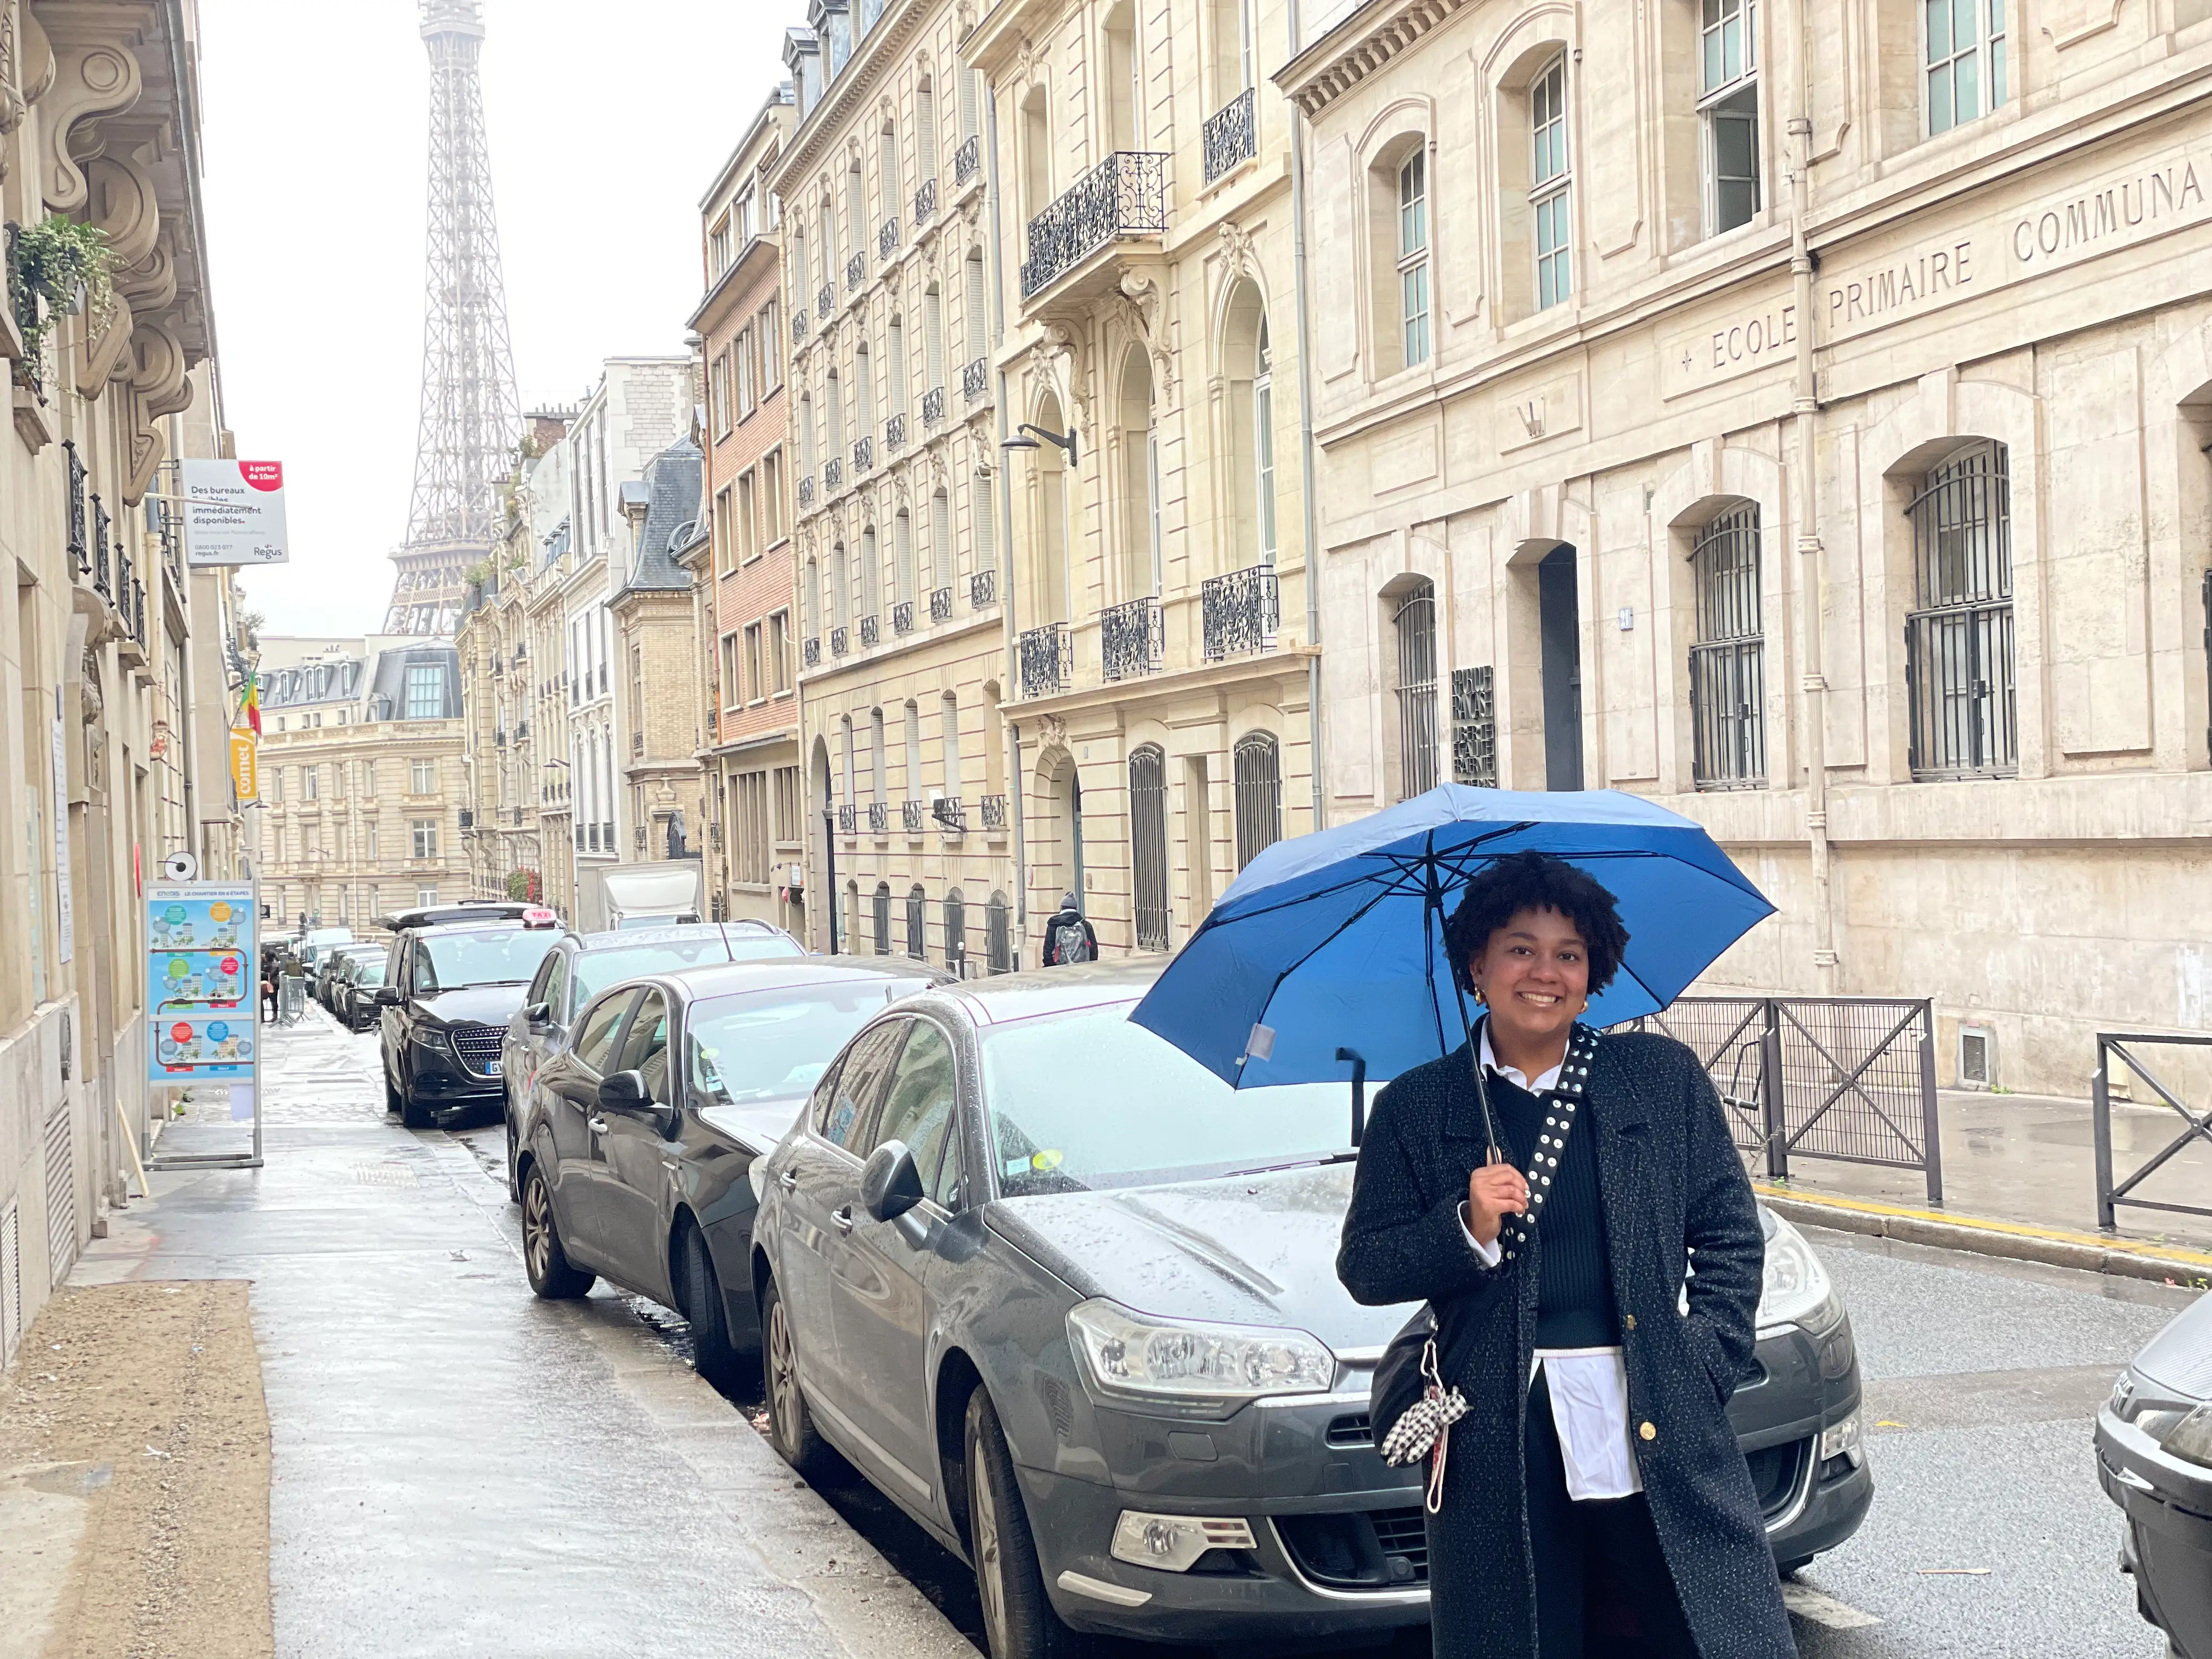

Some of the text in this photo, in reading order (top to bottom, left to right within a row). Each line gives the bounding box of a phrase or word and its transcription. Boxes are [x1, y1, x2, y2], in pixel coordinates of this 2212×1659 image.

[1712, 159, 2211, 369] ECOLE PRIMAIRE COMMUNA
[255, 465, 276, 473] partir
[193, 506, 262, 514] immédiatement
[193, 516, 245, 526] disponibles.
[254, 547, 282, 560] Regus
[1620, 609, 1628, 627] 21
[237, 744, 251, 794] comet
